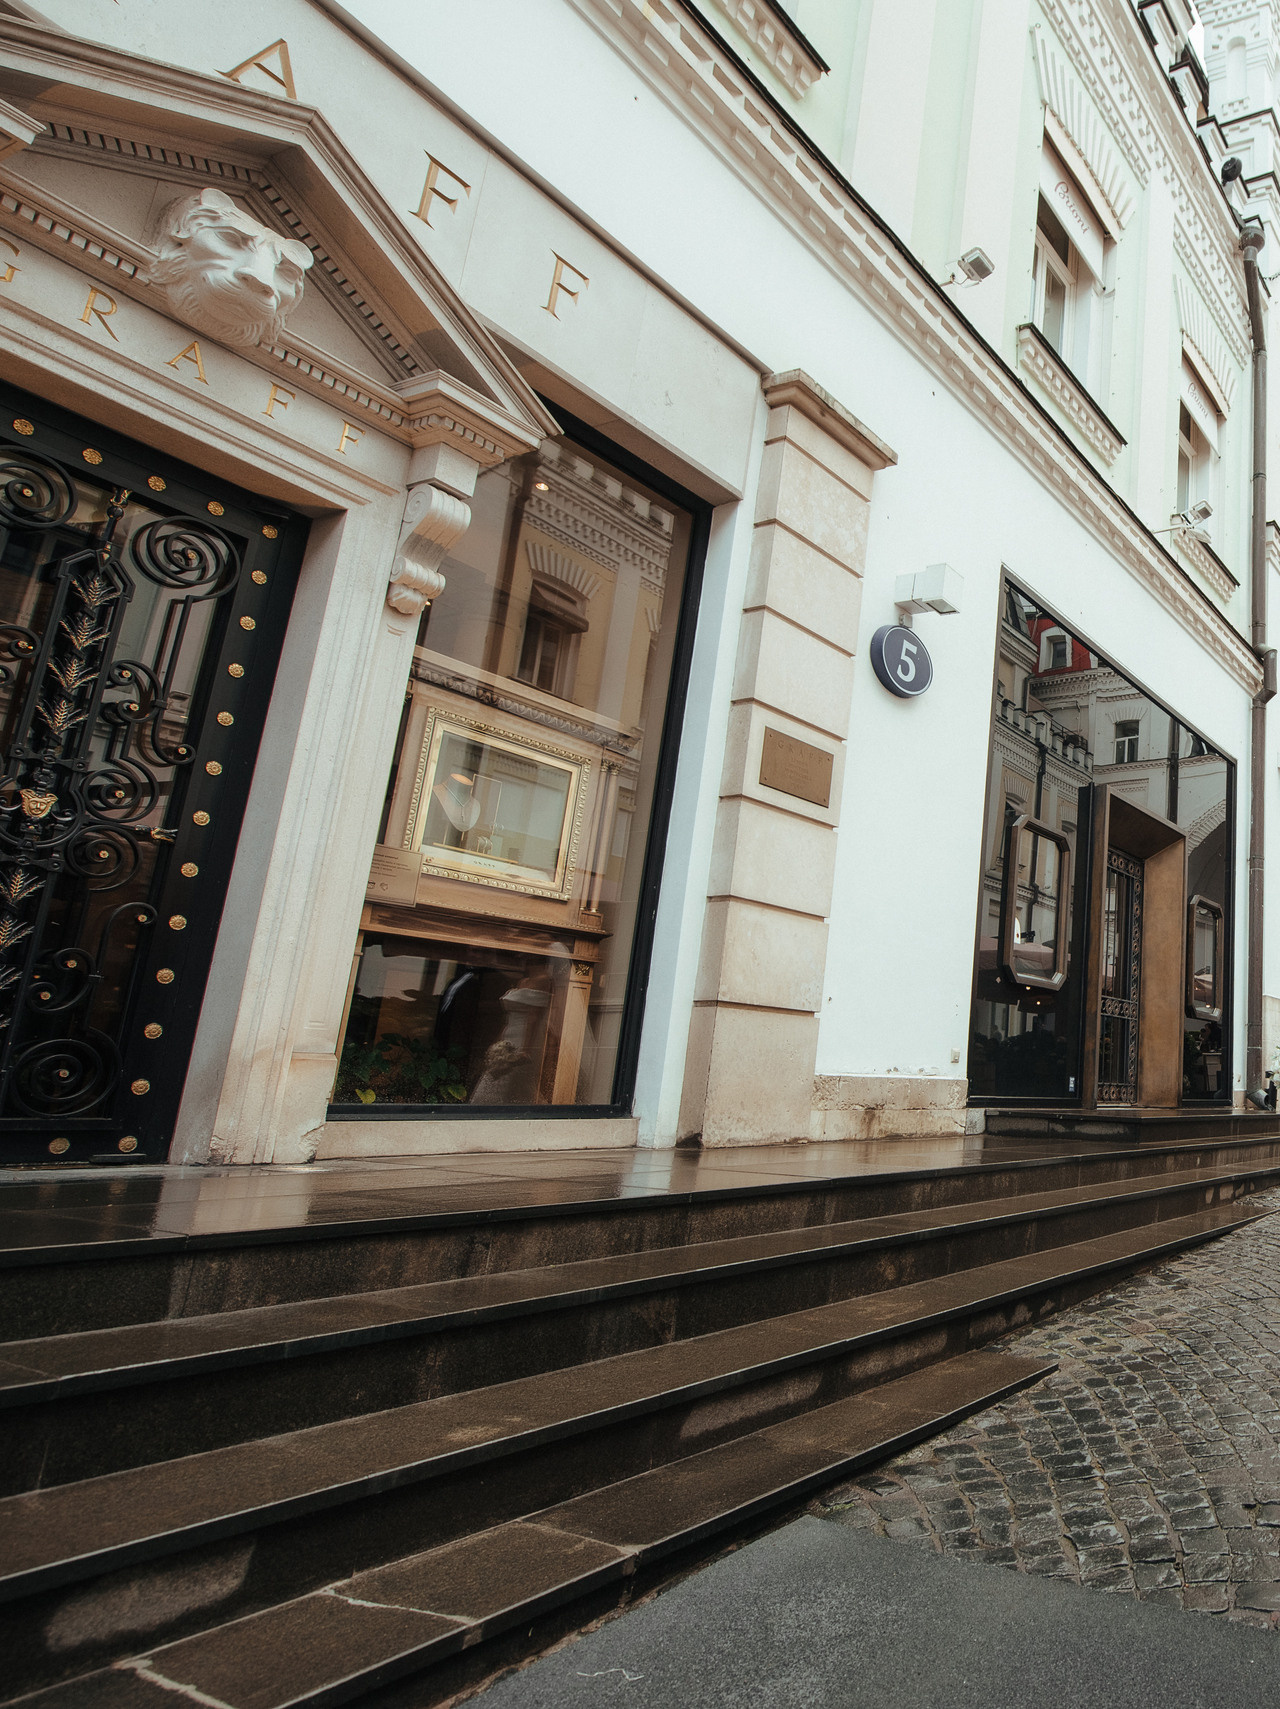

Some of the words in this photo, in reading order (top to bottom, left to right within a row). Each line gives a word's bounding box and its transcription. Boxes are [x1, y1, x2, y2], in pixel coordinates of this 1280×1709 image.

[112, 0, 590, 321] AFF
[1055, 181, 1089, 234] Brioni
[897, 639, 917, 682] 5
